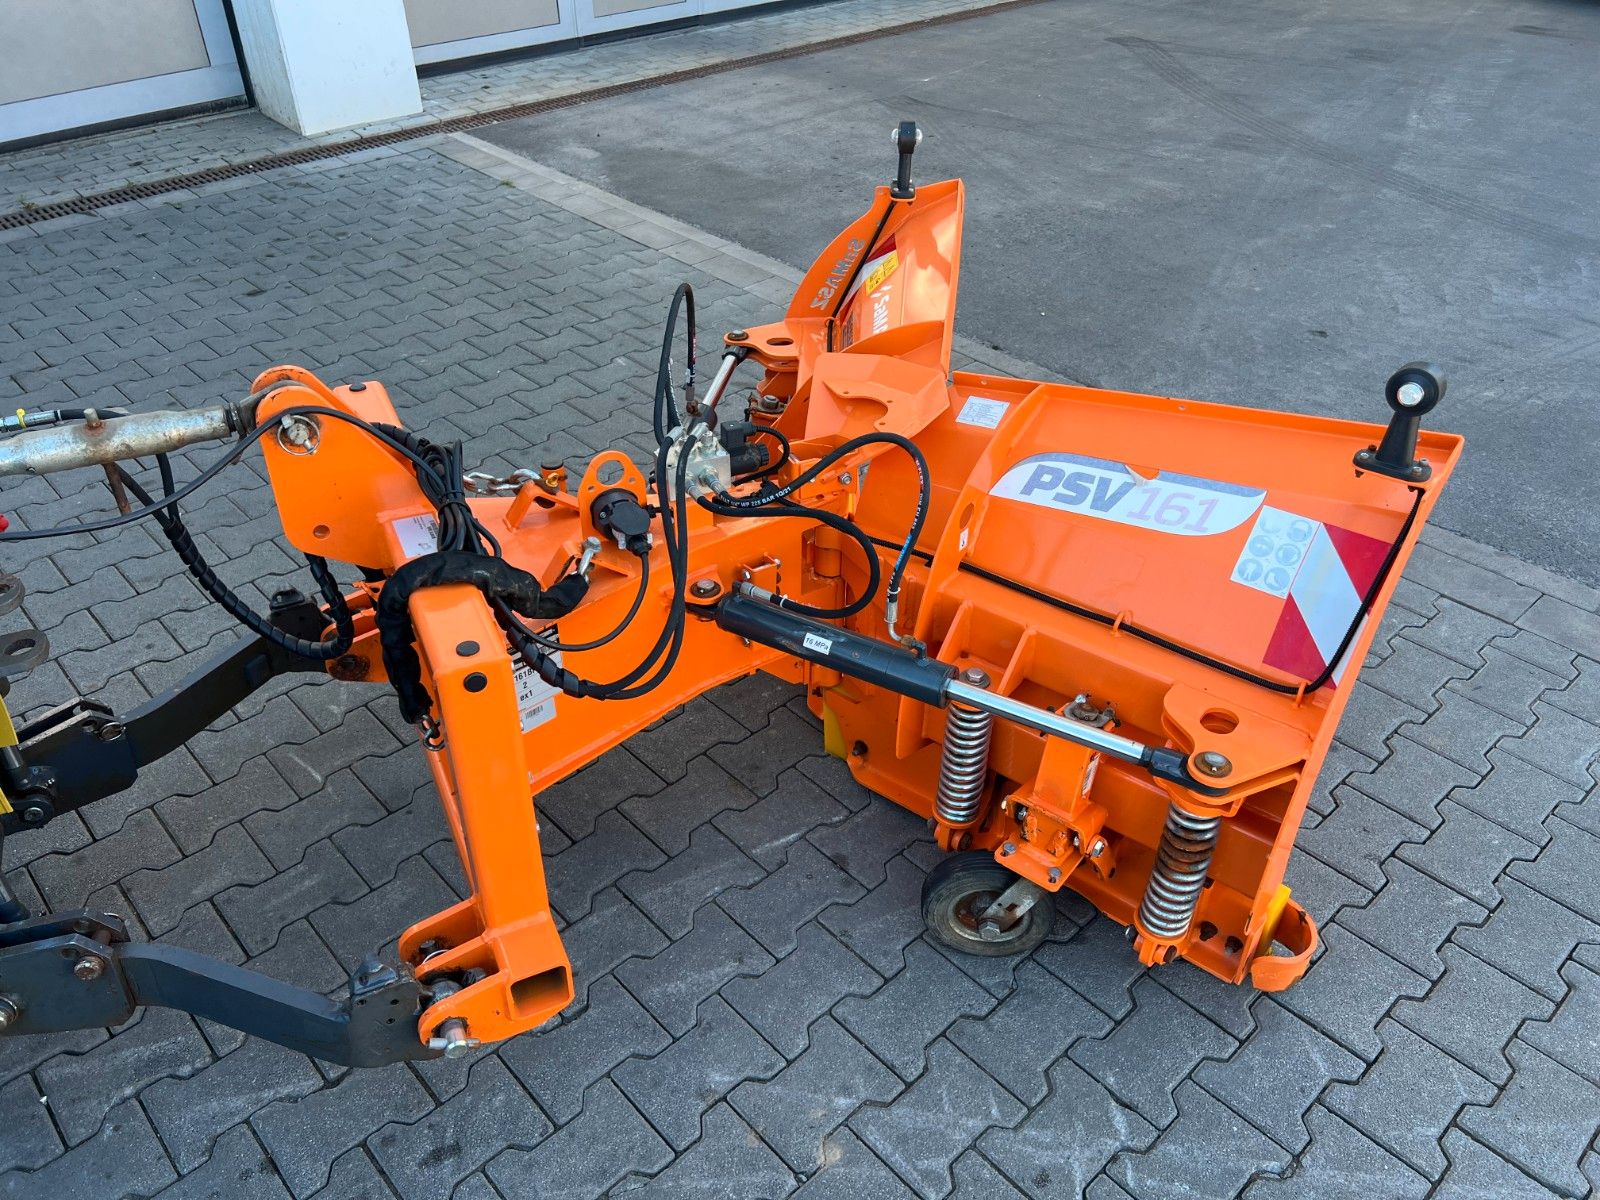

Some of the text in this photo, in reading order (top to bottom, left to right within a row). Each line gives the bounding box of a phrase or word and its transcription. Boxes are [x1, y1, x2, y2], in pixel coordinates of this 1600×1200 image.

[762, 495, 775, 504] BAR
[1020, 464, 1220, 532] PSV 161
[814, 640, 829, 650] MPa
[522, 681, 528, 689] 2
